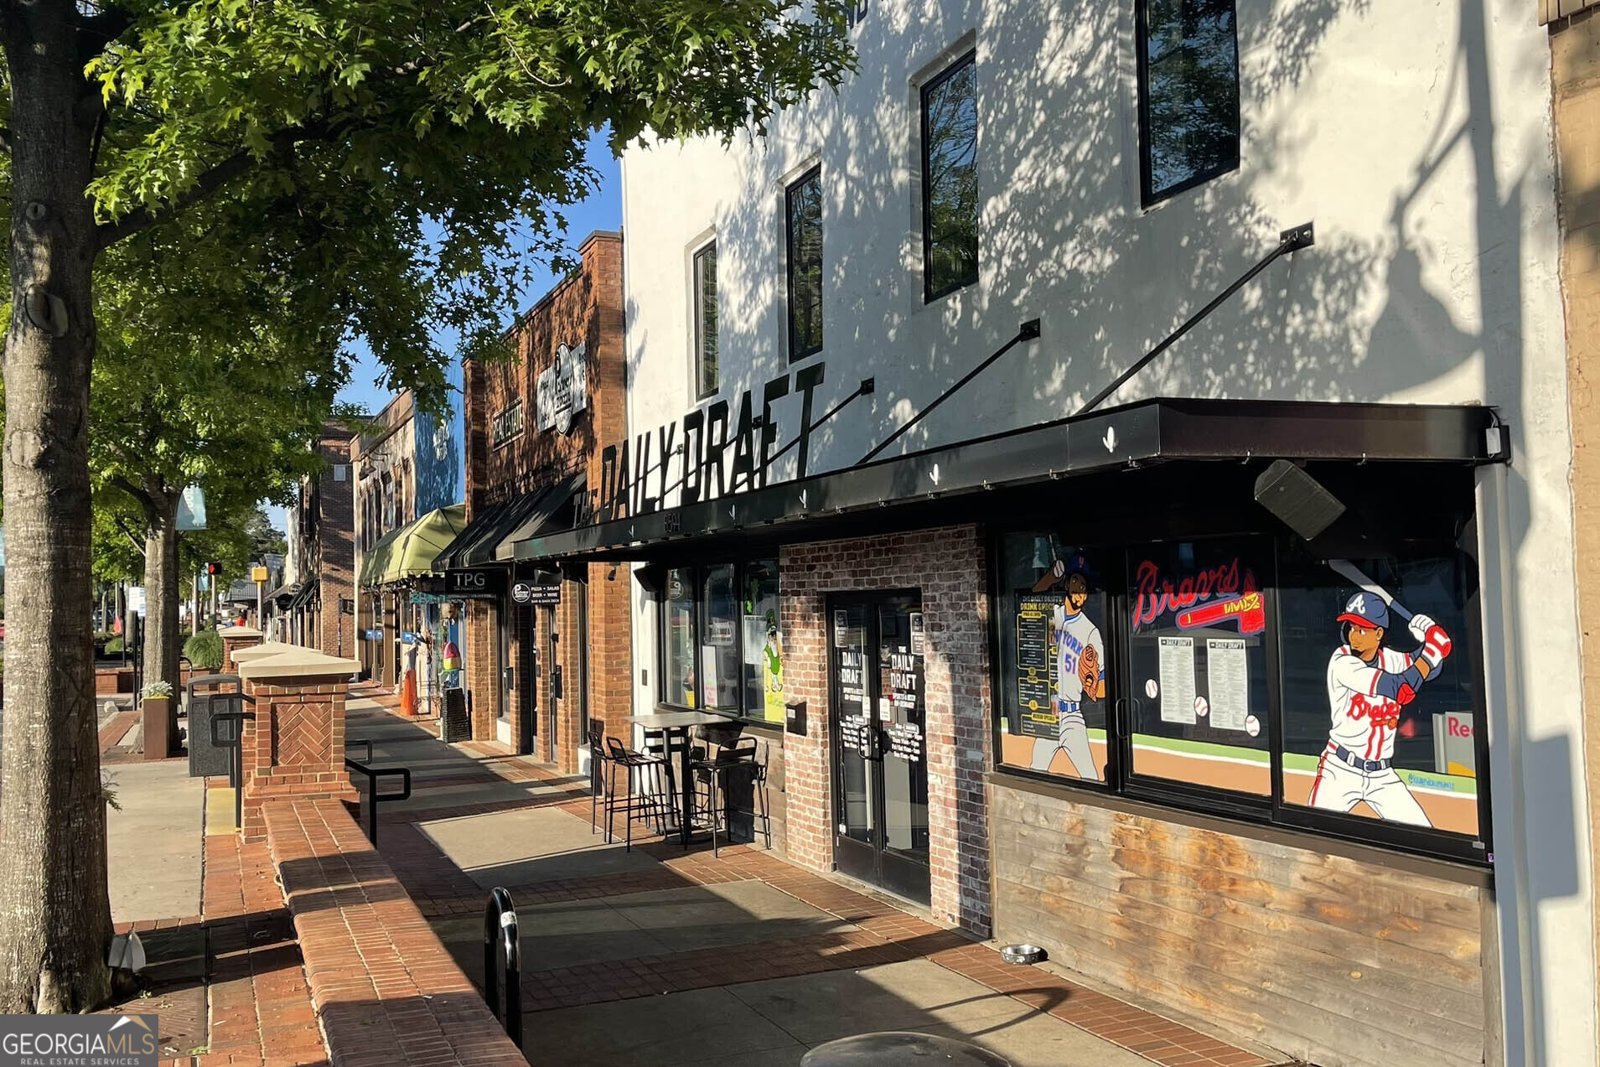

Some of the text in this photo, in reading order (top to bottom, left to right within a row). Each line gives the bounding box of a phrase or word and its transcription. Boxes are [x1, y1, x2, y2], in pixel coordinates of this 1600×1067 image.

[573, 488, 599, 529] THE
[601, 421, 677, 524] DAILY
[680, 362, 825, 506] DRAFT
[453, 573, 485, 586] TPG
[1133, 558, 1240, 630] Braves
[1345, 594, 1366, 614] A
[1063, 630, 1084, 656] YORK
[842, 652, 862, 666] DAILY
[891, 655, 914, 671] DAILY
[1064, 653, 1077, 675] 51
[841, 669, 862, 684] DRAFT
[890, 672, 917, 690] DRAFT
